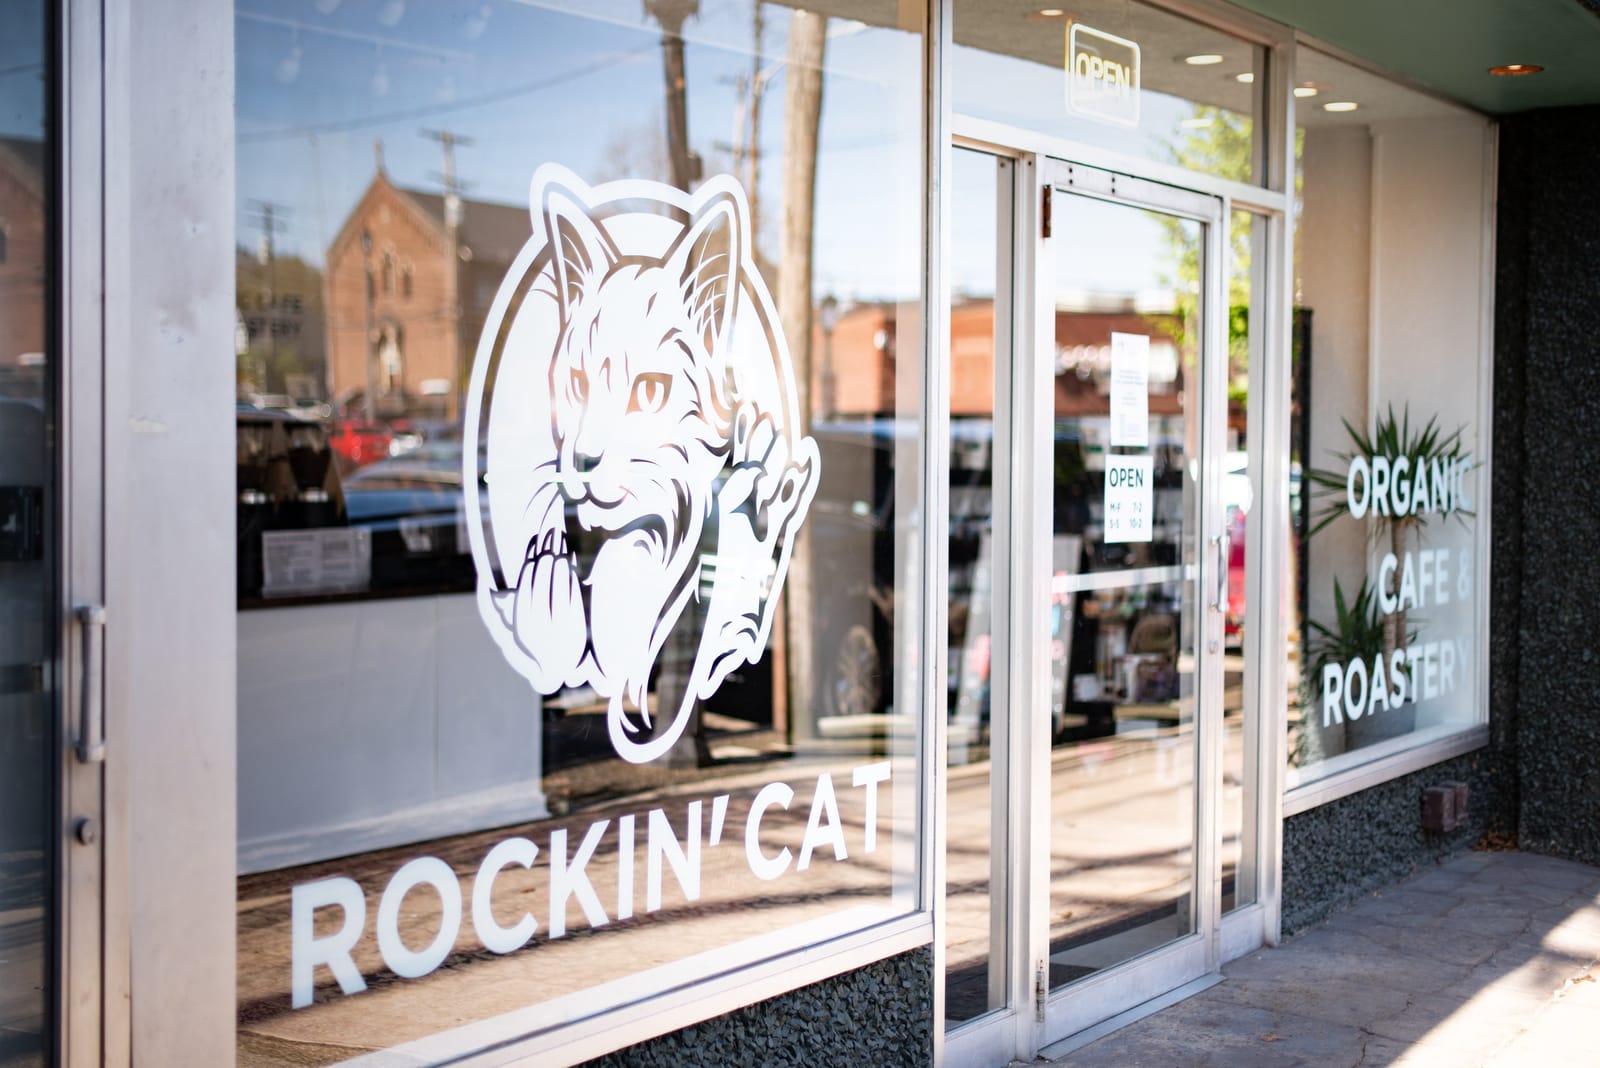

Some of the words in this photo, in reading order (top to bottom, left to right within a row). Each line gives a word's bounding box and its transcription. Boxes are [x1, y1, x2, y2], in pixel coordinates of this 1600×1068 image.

[1075, 52, 1130, 98] OPEN
[1108, 467, 1144, 488] OPEN
[1346, 454, 1474, 520] ORGANIC
[1378, 548, 1450, 615] CAFE
[1457, 547, 1472, 599] &
[1322, 638, 1473, 728] ROASTERY
[291, 795, 730, 1010] ROCKIN'
[744, 761, 891, 881] CAT
